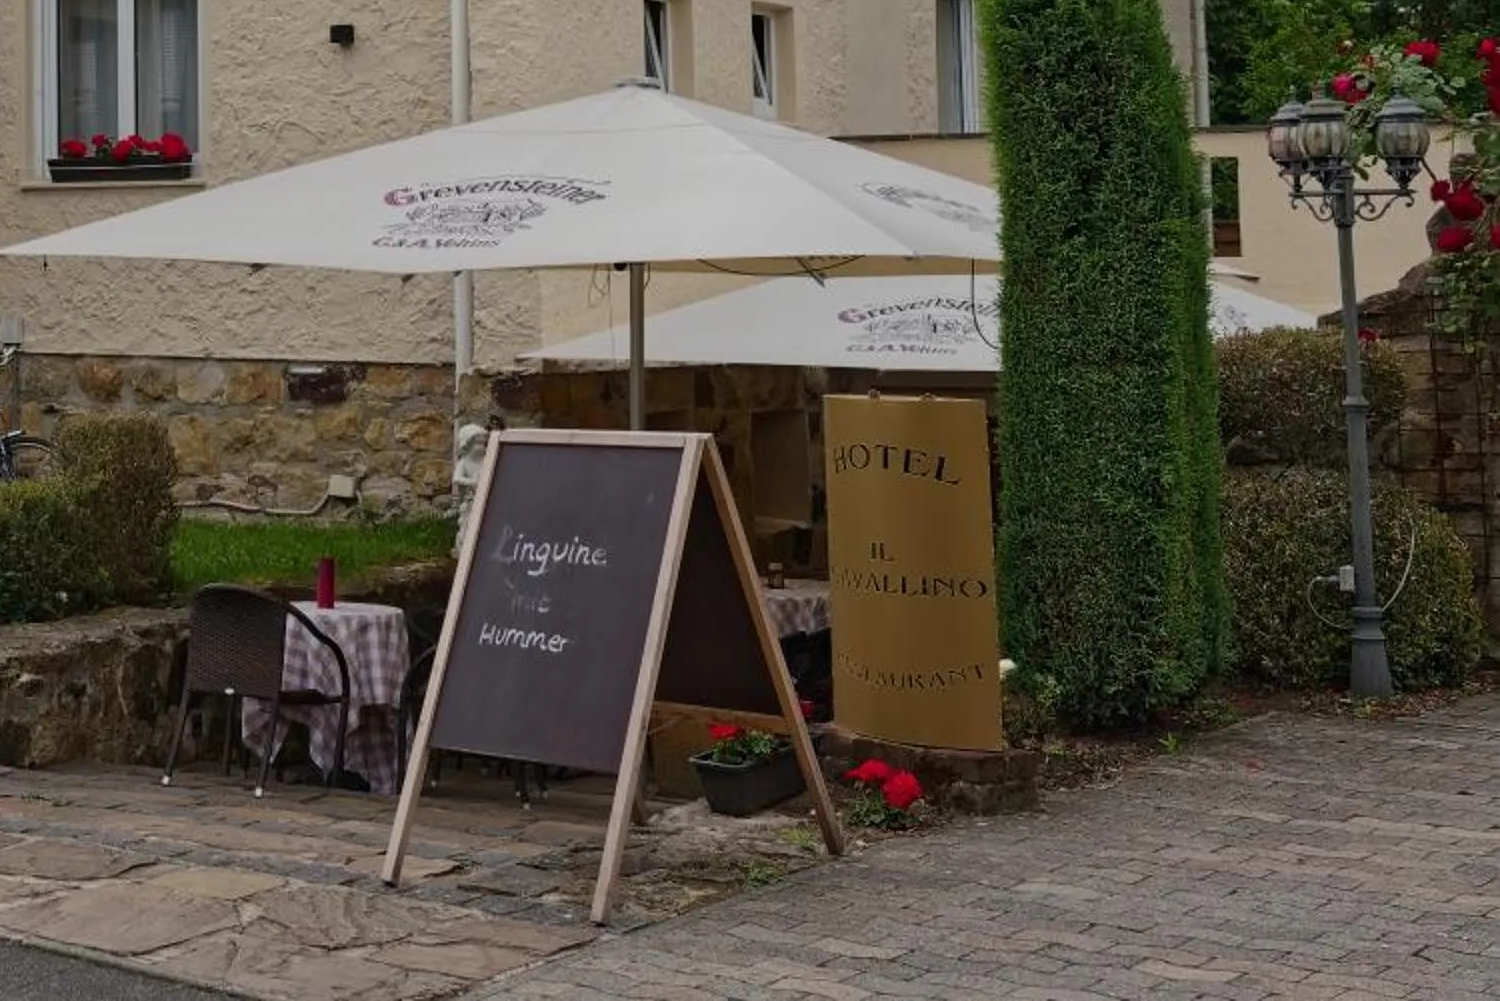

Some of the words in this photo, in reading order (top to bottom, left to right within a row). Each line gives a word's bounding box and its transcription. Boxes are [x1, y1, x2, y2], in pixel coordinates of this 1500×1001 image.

[834, 443, 963, 486] HOTEL
[869, 541, 896, 562] IL
[832, 565, 989, 599] AVALLINO
[479, 621, 571, 653] Hummer
